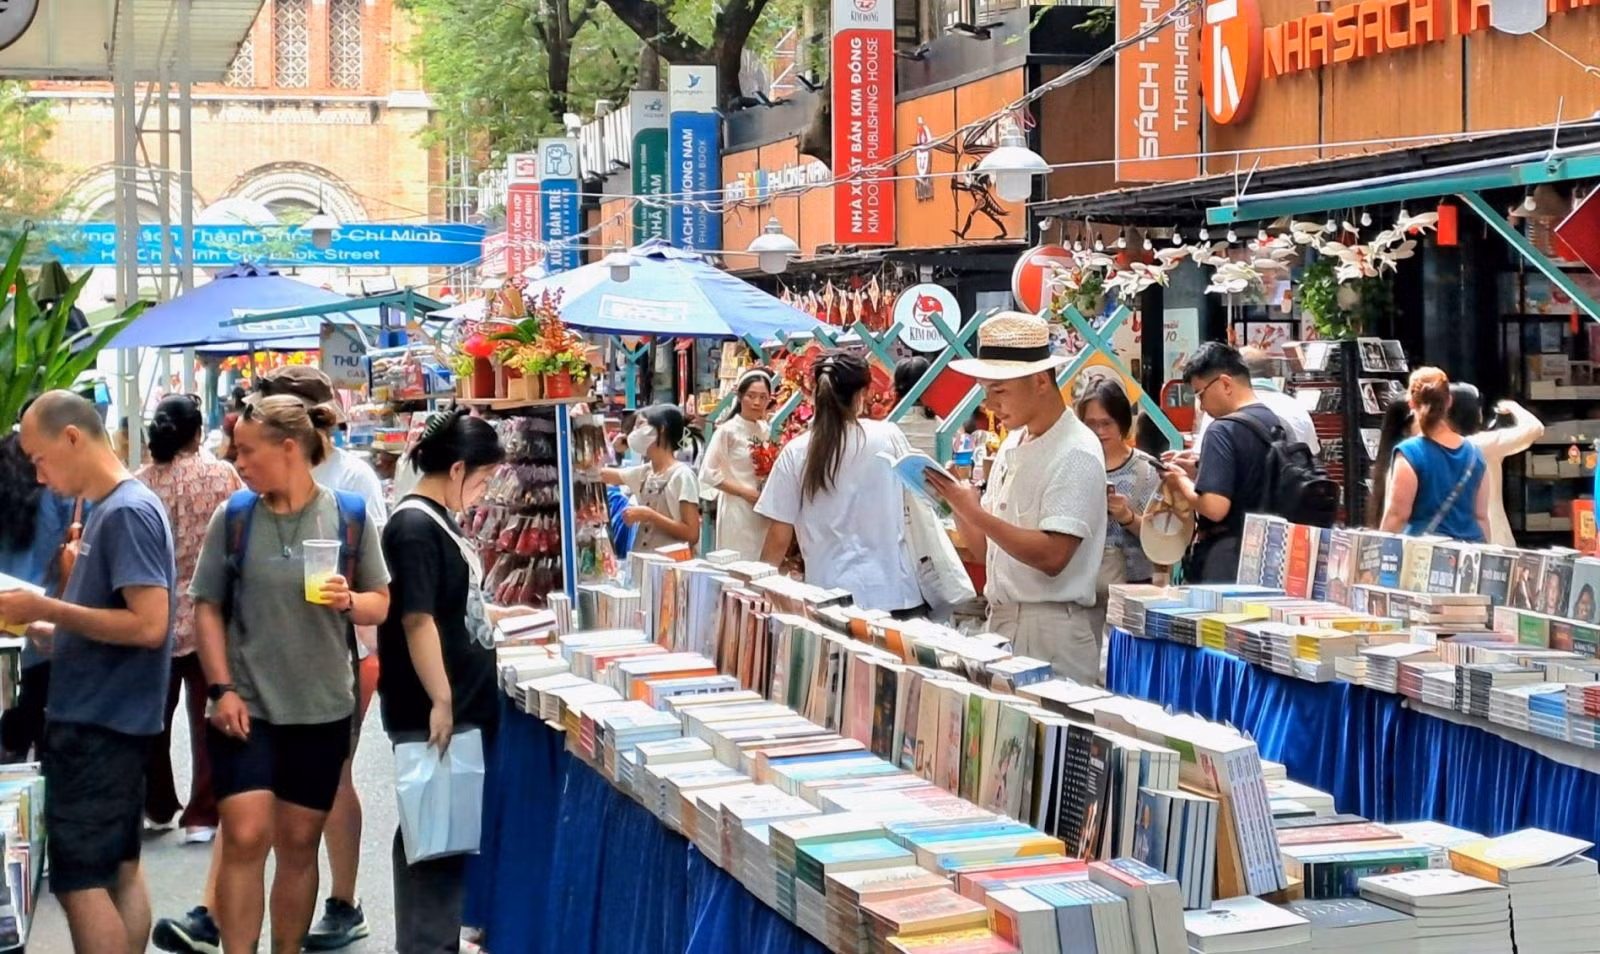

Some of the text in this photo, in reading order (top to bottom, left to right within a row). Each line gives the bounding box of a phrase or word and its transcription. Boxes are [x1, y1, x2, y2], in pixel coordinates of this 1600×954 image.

[867, 37, 879, 81] HOUSE
[1134, 0, 1159, 158] SÁCH TH
[851, 89, 862, 117] KIM
[867, 84, 879, 159] PUBLISHING
[682, 128, 693, 158] NAM
[698, 201, 707, 243] PHUON
[848, 199, 862, 233] NHÀ
[867, 210, 879, 233] KIM
[349, 229, 384, 241] Chí
[391, 229, 442, 242] Minh
[324, 248, 381, 261] Street
